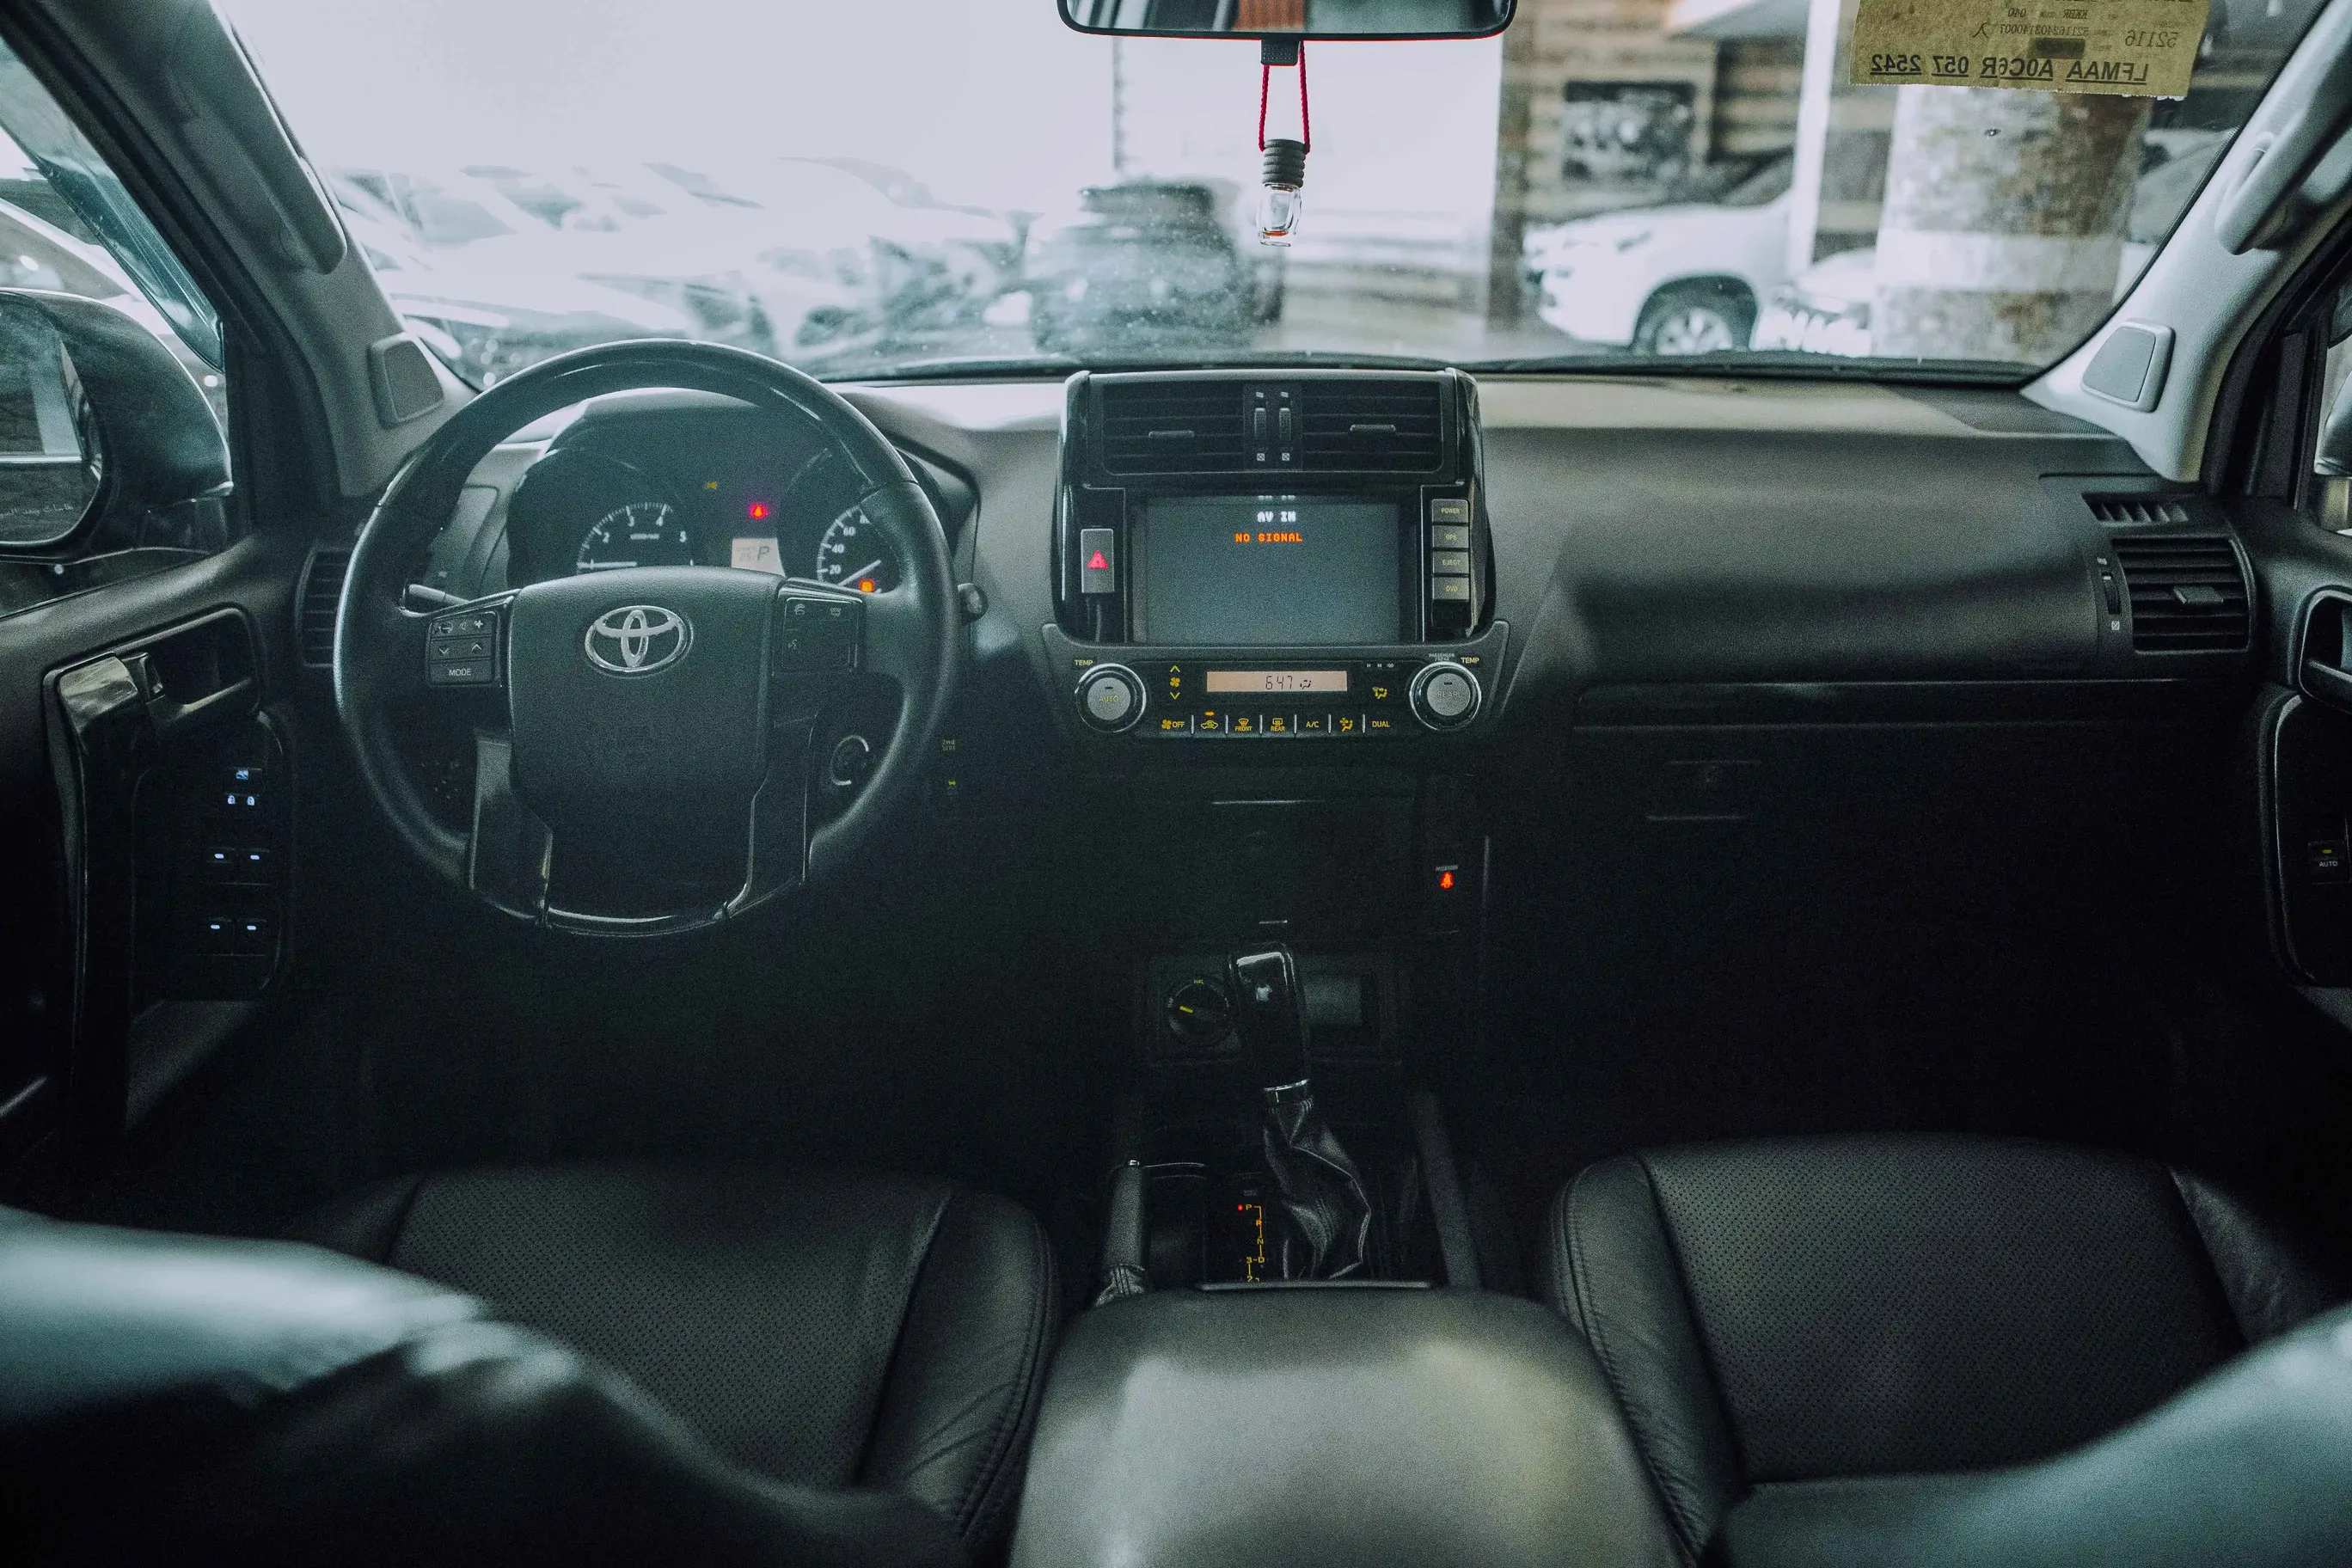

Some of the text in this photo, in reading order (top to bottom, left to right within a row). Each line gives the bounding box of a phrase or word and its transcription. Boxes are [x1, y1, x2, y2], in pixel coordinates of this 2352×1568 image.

[1257, 511, 1296, 523] AV IN
[679, 530, 687, 542] 5
[843, 526, 856, 536] 60
[603, 531, 610, 543] 2
[1234, 532, 1303, 543] NO SIGNAL
[757, 545, 769, 560] P
[831, 543, 845, 554] 40
[830, 565, 842, 575] 20
[449, 668, 471, 677] MODE
